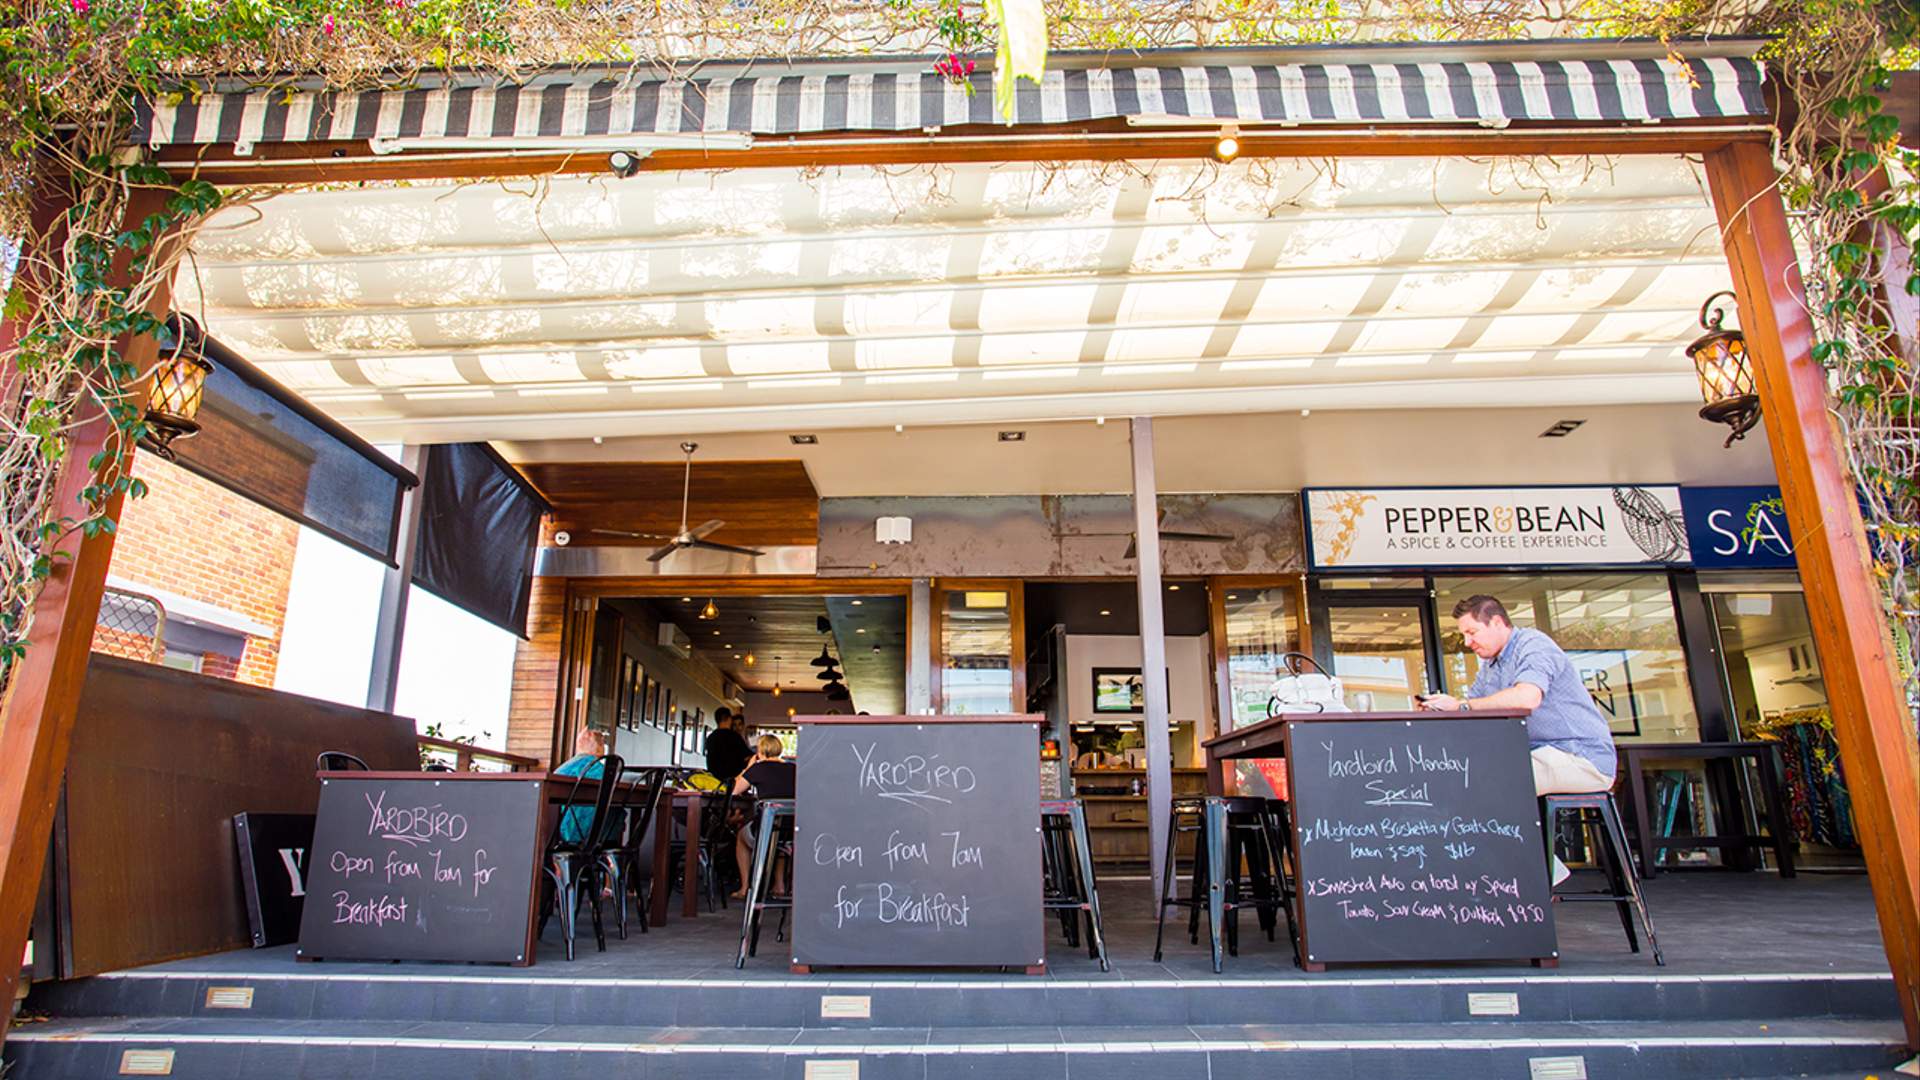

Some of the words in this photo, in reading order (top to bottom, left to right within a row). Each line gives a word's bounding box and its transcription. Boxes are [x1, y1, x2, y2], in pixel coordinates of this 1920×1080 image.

[1385, 506, 1606, 533] PEPPER&BEAN
[1387, 537, 1397, 549] A
[1401, 537, 1440, 549] SPICE
[1446, 538, 1456, 548] &
[1460, 536, 1515, 548] COFFEE
[1522, 535, 1608, 548] EXPERIENCE
[1406, 745, 1470, 788] Monday
[1365, 779, 1430, 806] Special
[814, 833, 863, 868] Open
[882, 830, 929, 872] from
[941, 831, 984, 869] 7am
[330, 851, 374, 878] Open
[384, 850, 421, 884] from
[428, 850, 462, 886] 7am
[473, 849, 497, 897] for
[1411, 880, 1429, 893] on
[333, 890, 408, 927] Breakfast
[834, 885, 863, 928] for
[878, 882, 970, 931] Breakfast
